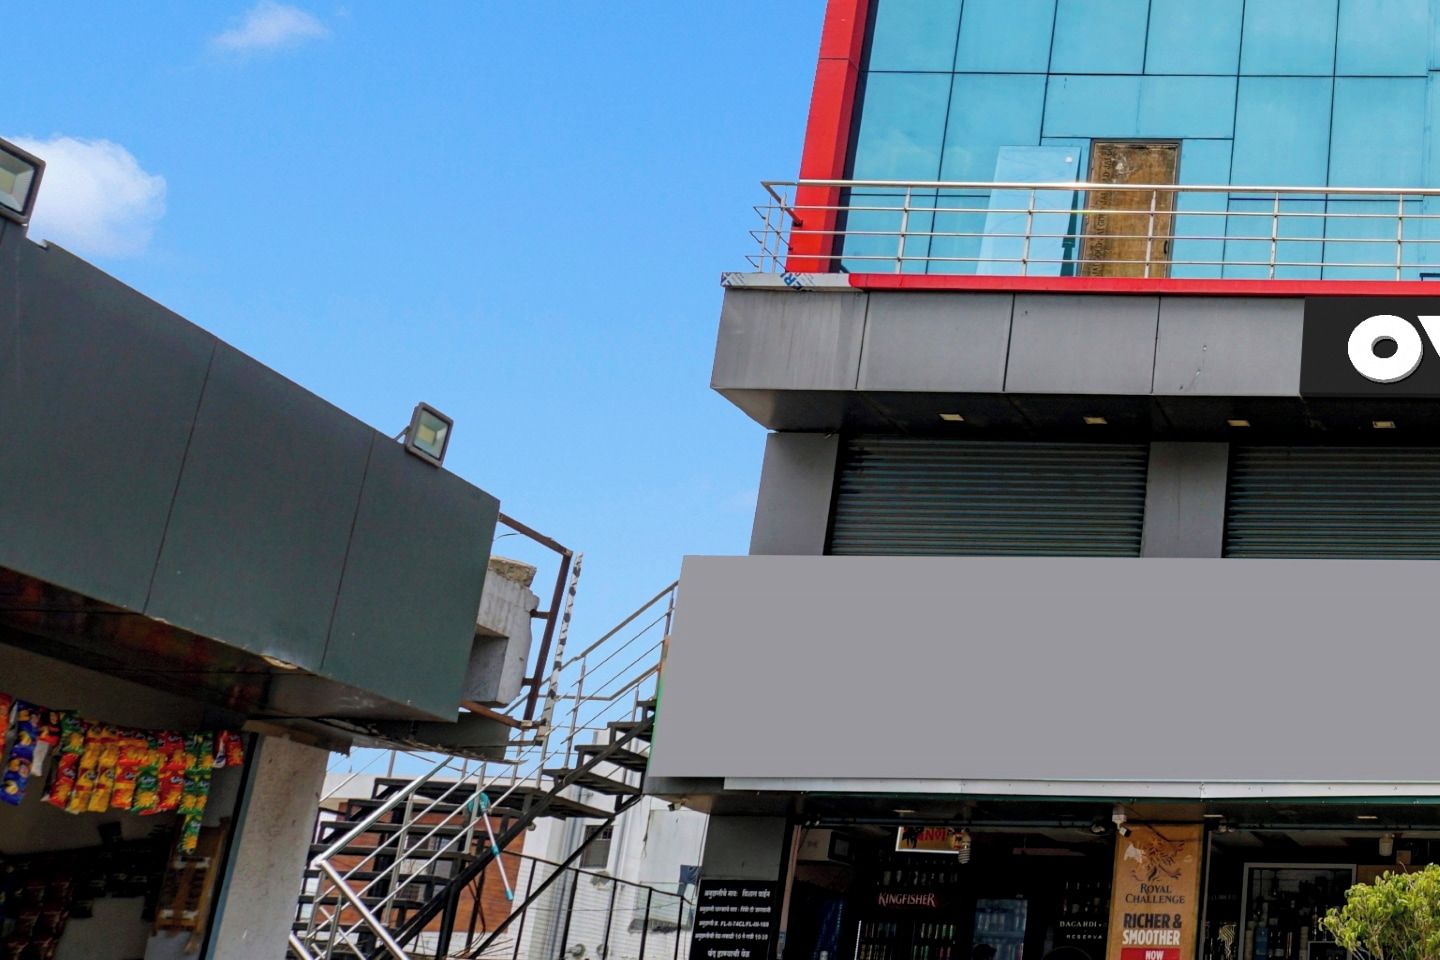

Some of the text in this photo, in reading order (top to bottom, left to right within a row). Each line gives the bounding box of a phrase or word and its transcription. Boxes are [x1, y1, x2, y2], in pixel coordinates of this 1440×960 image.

[1140, 883, 1172, 893] ROYAL
[878, 892, 936, 907] KINGFISHER
[1125, 893, 1185, 904] CHALLENGE
[1123, 913, 1182, 929] RICHER &
[1122, 929, 1181, 945] SMOOTHER
[1145, 950, 1164, 960] NOW
